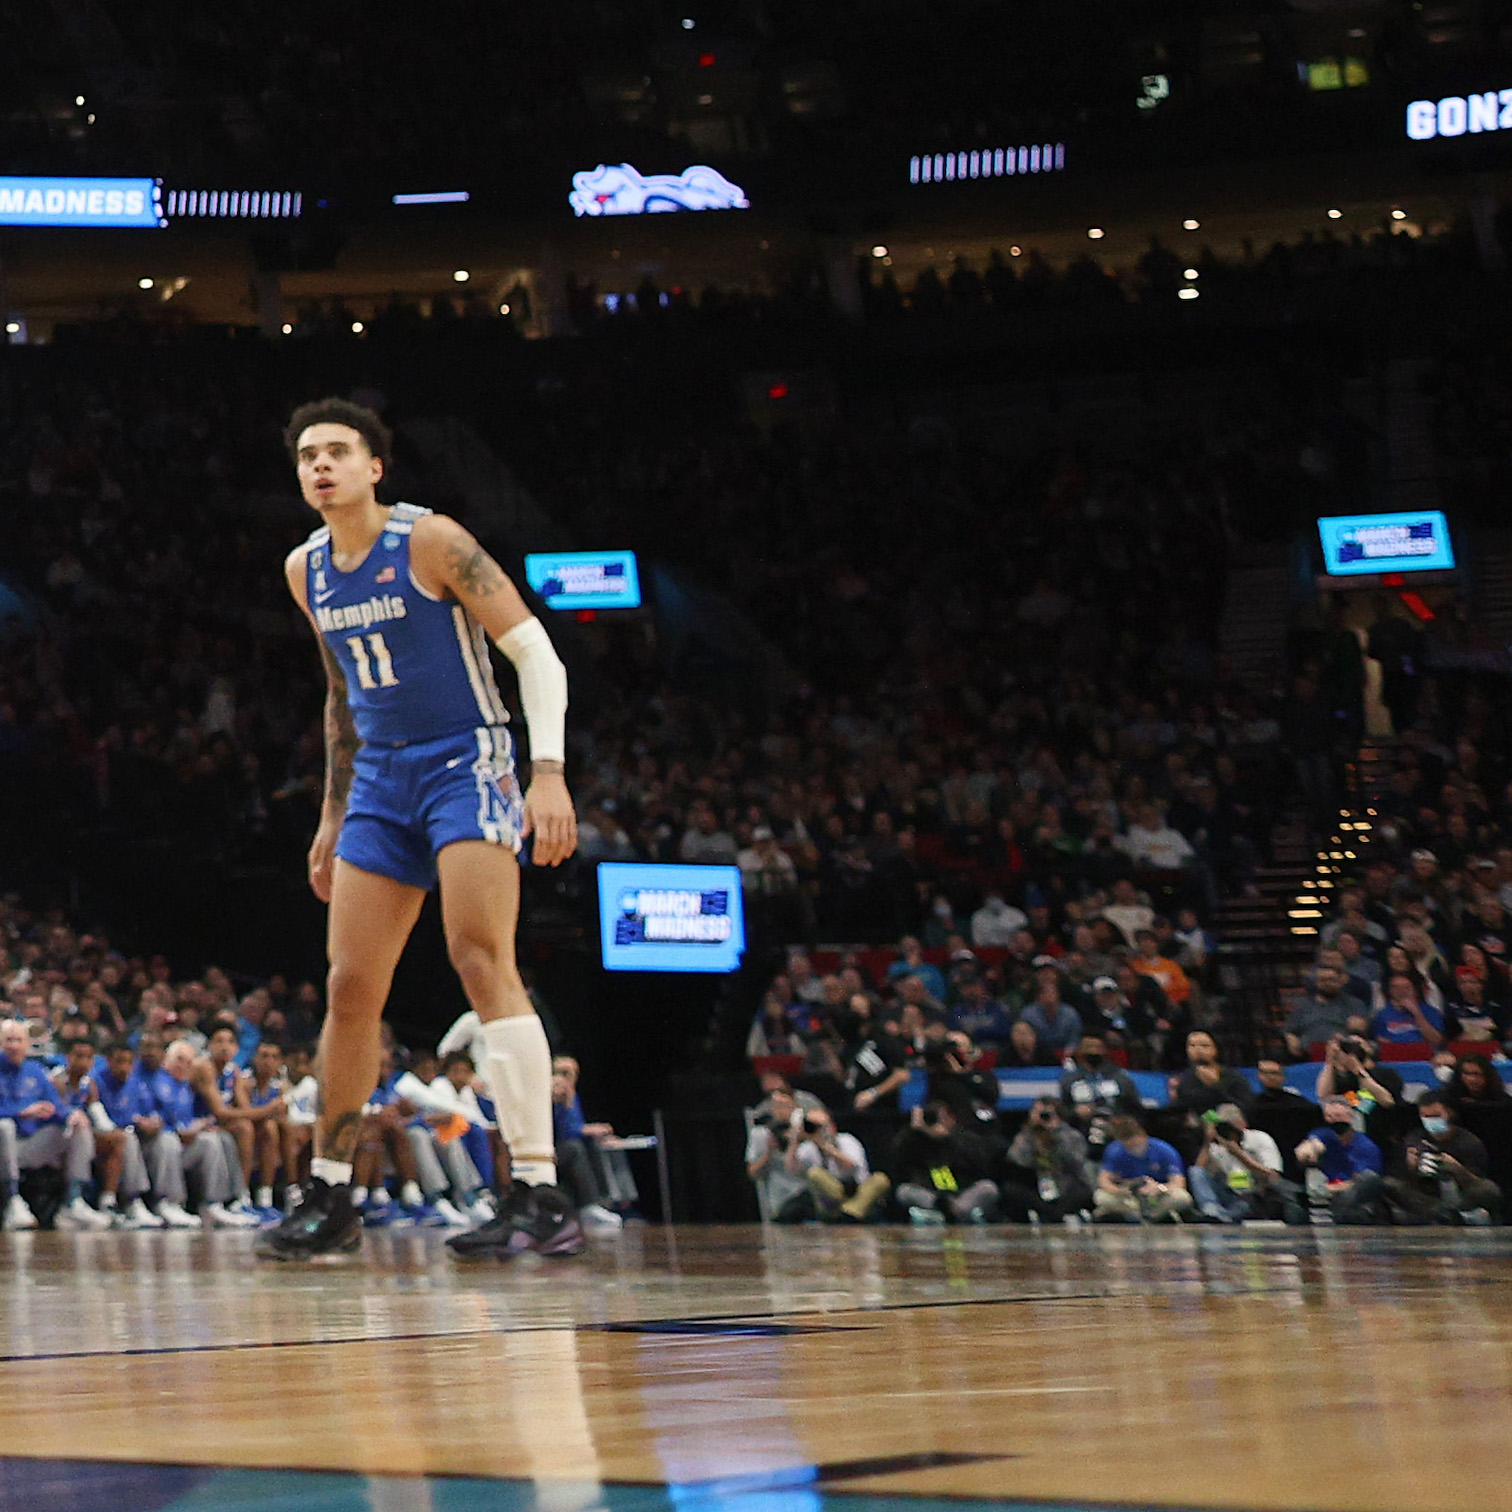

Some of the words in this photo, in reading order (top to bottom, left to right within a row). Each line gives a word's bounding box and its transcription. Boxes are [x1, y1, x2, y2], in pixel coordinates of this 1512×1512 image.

[1406, 87, 1512, 140] GONZ
[315, 593, 408, 634] Memphis
[346, 632, 401, 689] 11
